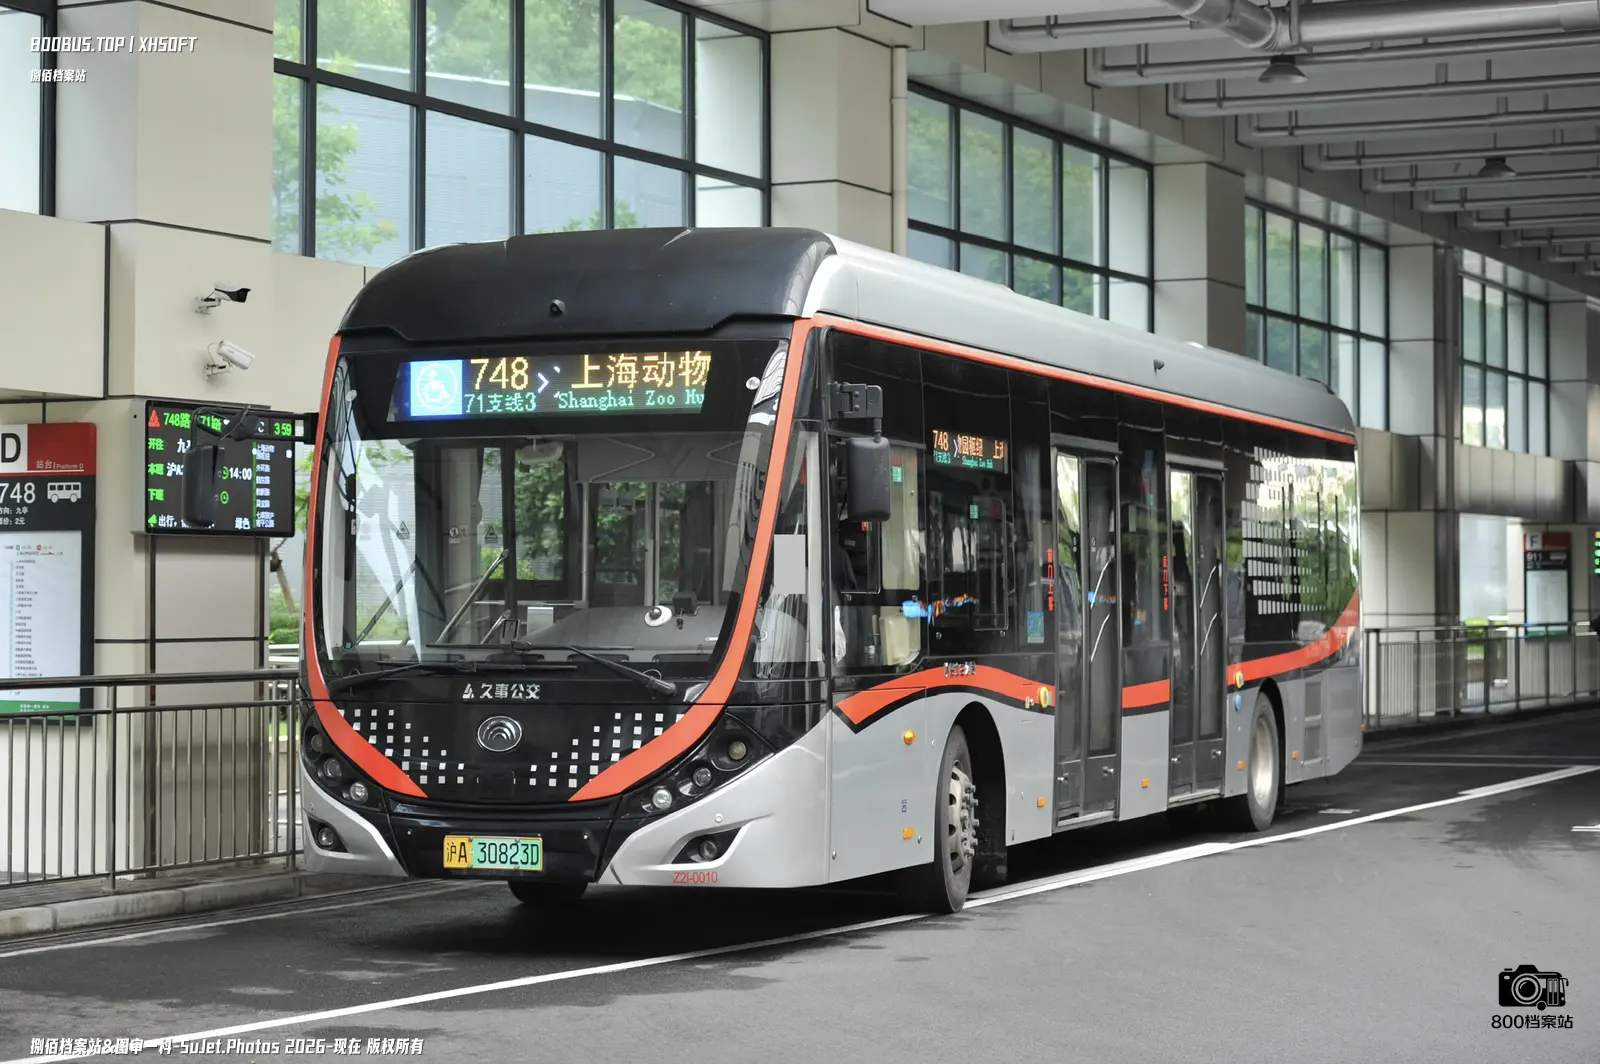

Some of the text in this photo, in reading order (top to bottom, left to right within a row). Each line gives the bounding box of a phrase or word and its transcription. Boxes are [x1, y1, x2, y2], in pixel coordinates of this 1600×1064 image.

[470, 357, 529, 390] 748
[571, 351, 712, 389] 上海动物
[464, 392, 537, 413] 71支线3
[558, 389, 635, 411] Shanghai
[646, 390, 676, 406] Zoo
[163, 413, 191, 429] 748路
[1, 433, 21, 463] D
[933, 430, 949, 451] 748
[36, 460, 52, 469] 站台
[228, 467, 252, 480] 14:00
[0, 482, 36, 504] 748
[480, 683, 540, 699] 久事公交
[446, 842, 539, 865] 沪A 30823D
